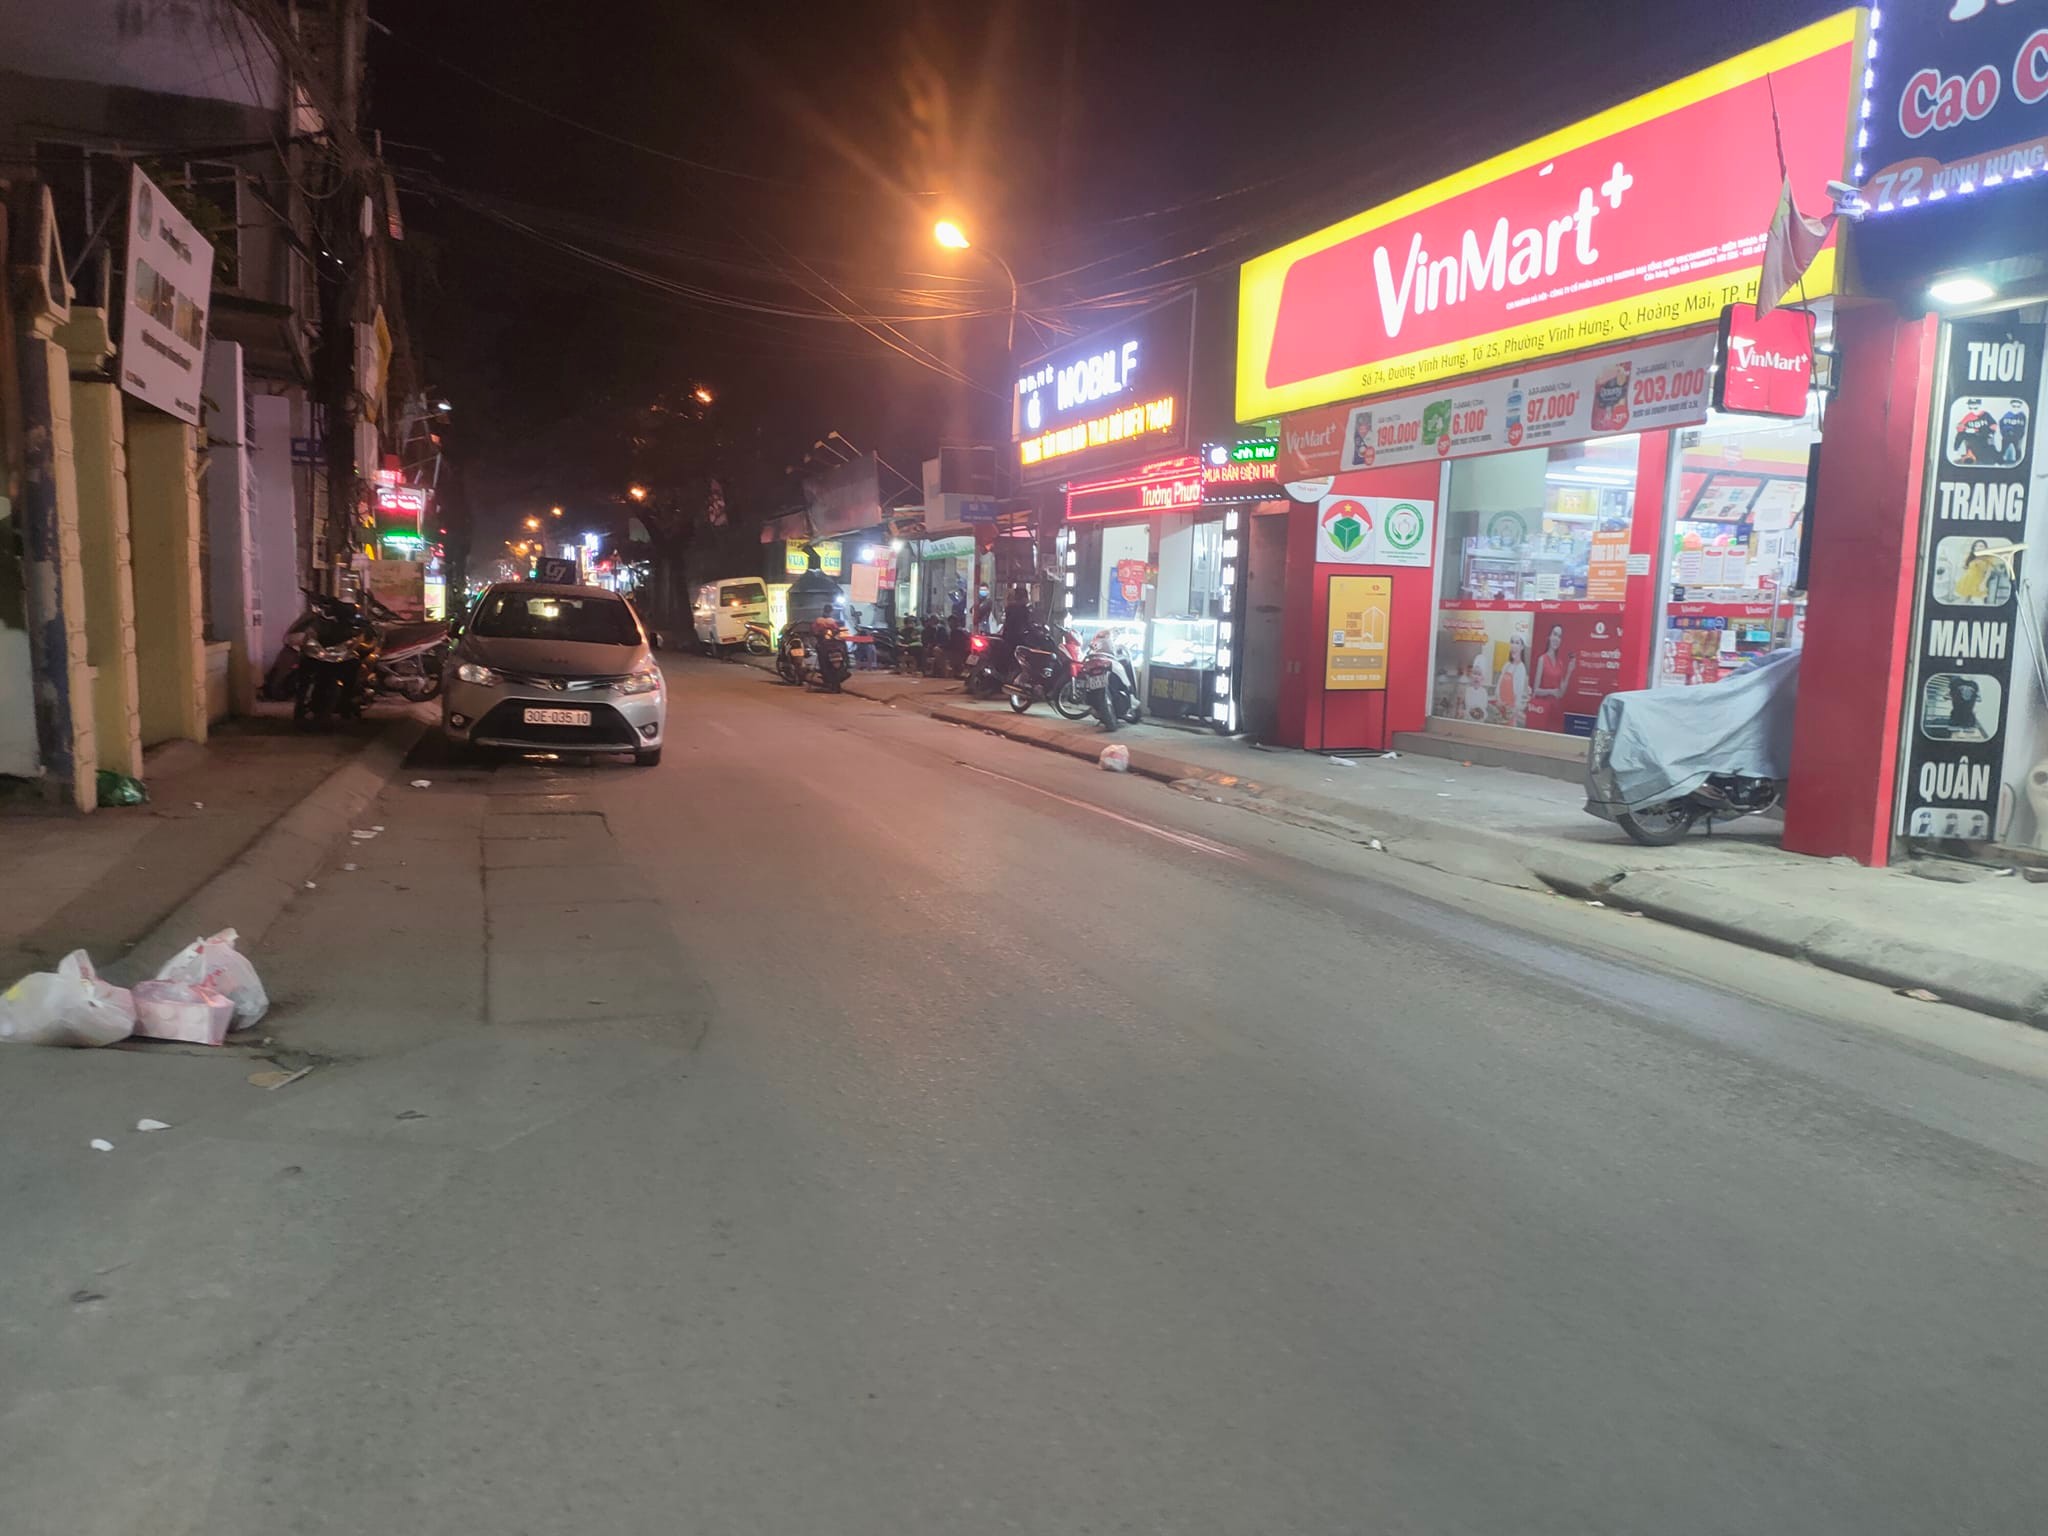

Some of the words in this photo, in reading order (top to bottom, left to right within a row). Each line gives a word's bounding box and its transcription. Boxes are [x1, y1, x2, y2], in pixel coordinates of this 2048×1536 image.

[1899, 65, 2000, 139] Cao
[1876, 166, 1923, 207] 72
[1932, 163, 1980, 190] VĨNH
[1986, 144, 2045, 177] HƯNG
[1361, 374, 1372, 387] Số
[1418, 359, 1439, 374] Vĩnh
[1504, 334, 1545, 354] Phường
[1549, 324, 1574, 343] Vĩnh
[1578, 317, 1614, 337] Hưng,
[1618, 314, 1631, 331] Q.
[1637, 302, 1680, 324] Hoàng
[1685, 293, 1715, 312] Mai,
[1967, 333, 2024, 383] THỜI
[1204, 468, 1220, 483] MUA
[1222, 464, 1239, 481] BÁN
[1939, 481, 2024, 523] TRANG
[1928, 620, 2008, 667] MẠNH
[1919, 756, 1990, 803] QUÂN
